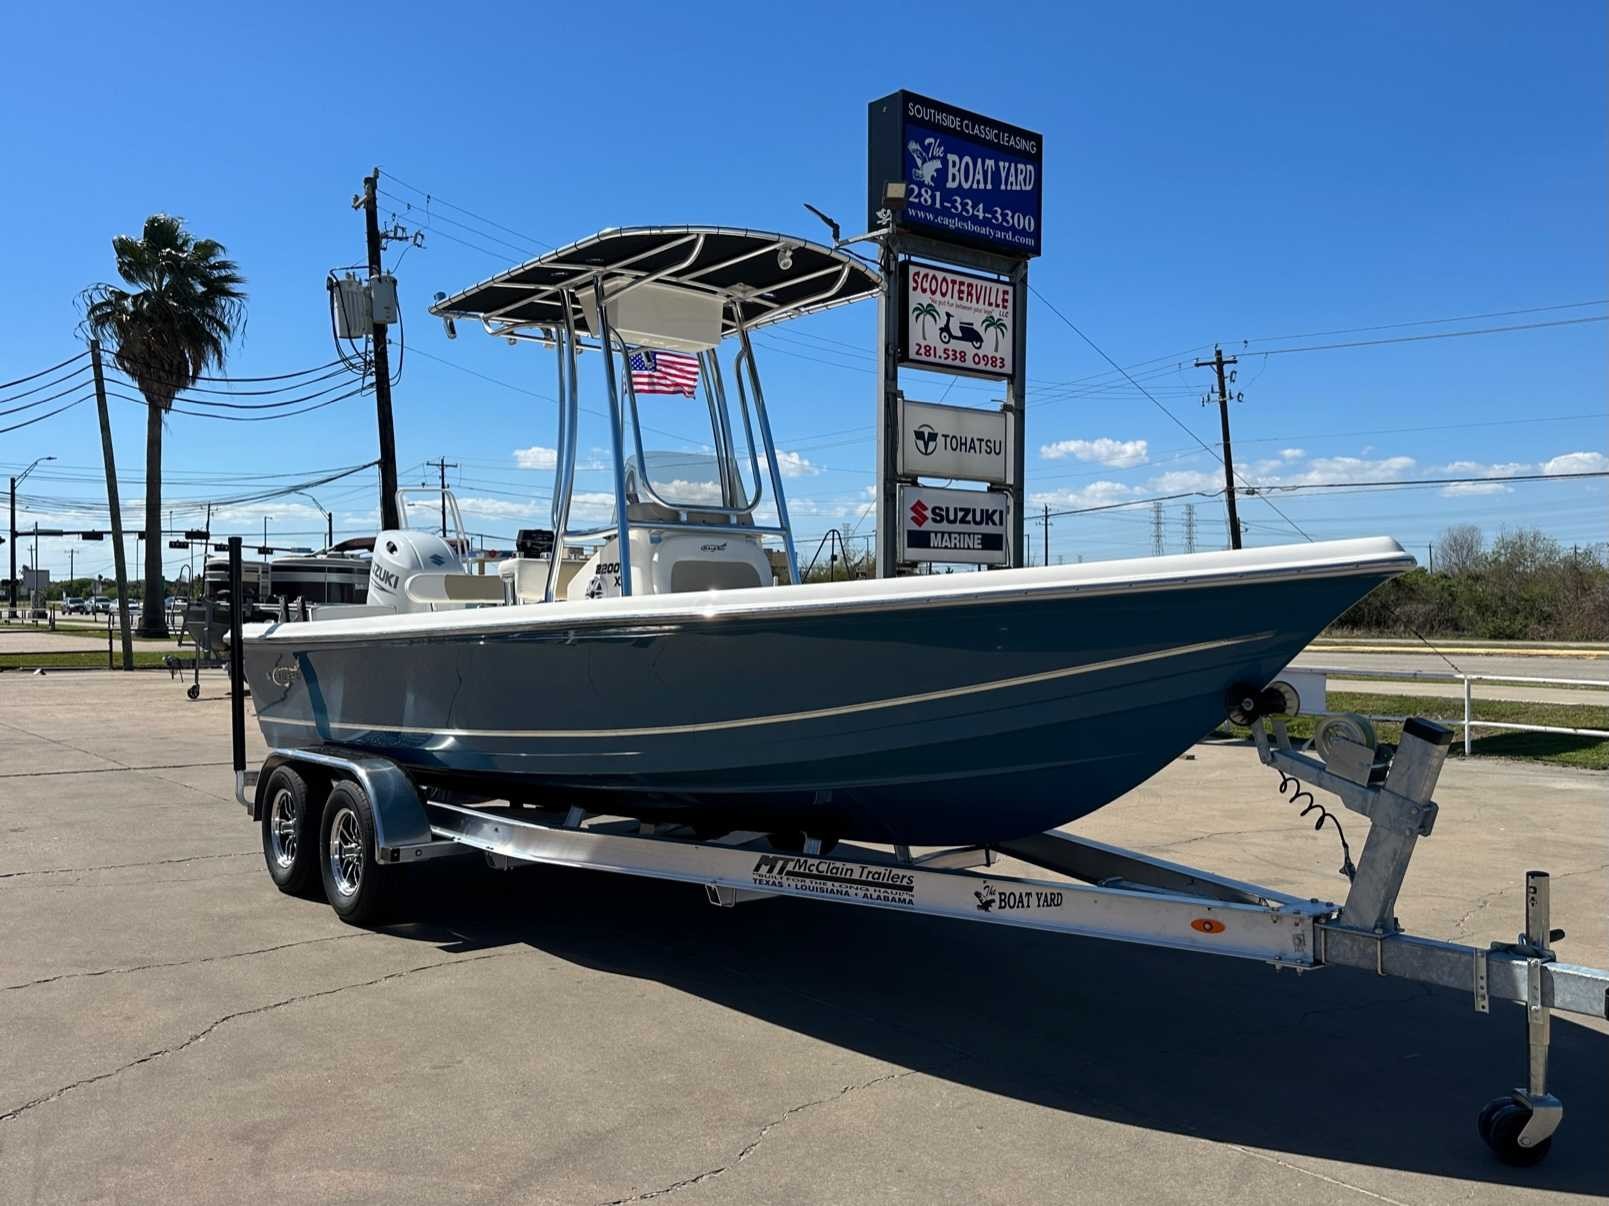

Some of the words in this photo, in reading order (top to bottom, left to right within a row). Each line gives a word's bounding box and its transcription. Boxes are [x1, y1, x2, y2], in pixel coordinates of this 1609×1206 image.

[908, 102, 961, 131] SOUTHSIDE
[962, 120, 998, 143] CLASSIC
[1000, 132, 1037, 154] LEASING
[924, 137, 945, 158] The
[946, 153, 995, 190] BOAT
[998, 161, 1035, 191] YARD
[908, 184, 1035, 232] 281-334-3300
[907, 207, 1035, 247] www.eaglesboatyard.com
[912, 271, 1009, 310] SCOOTERVILLE
[915, 343, 967, 363] 281.538
[972, 353, 1006, 369] 0983
[941, 433, 1002, 456] TOHATSU
[931, 505, 1003, 527] SUZUKI
[930, 532, 982, 549] MARINE
[792, 858, 854, 877] McClain
[859, 865, 914, 885] Trailers
[753, 878, 784, 888] TEXAS
[795, 883, 850, 897] LOUISIANA
[862, 893, 914, 905] ALABAMA
[983, 885, 997, 898] The
[998, 891, 1032, 909] BOAT
[1035, 892, 1064, 908] YARD
